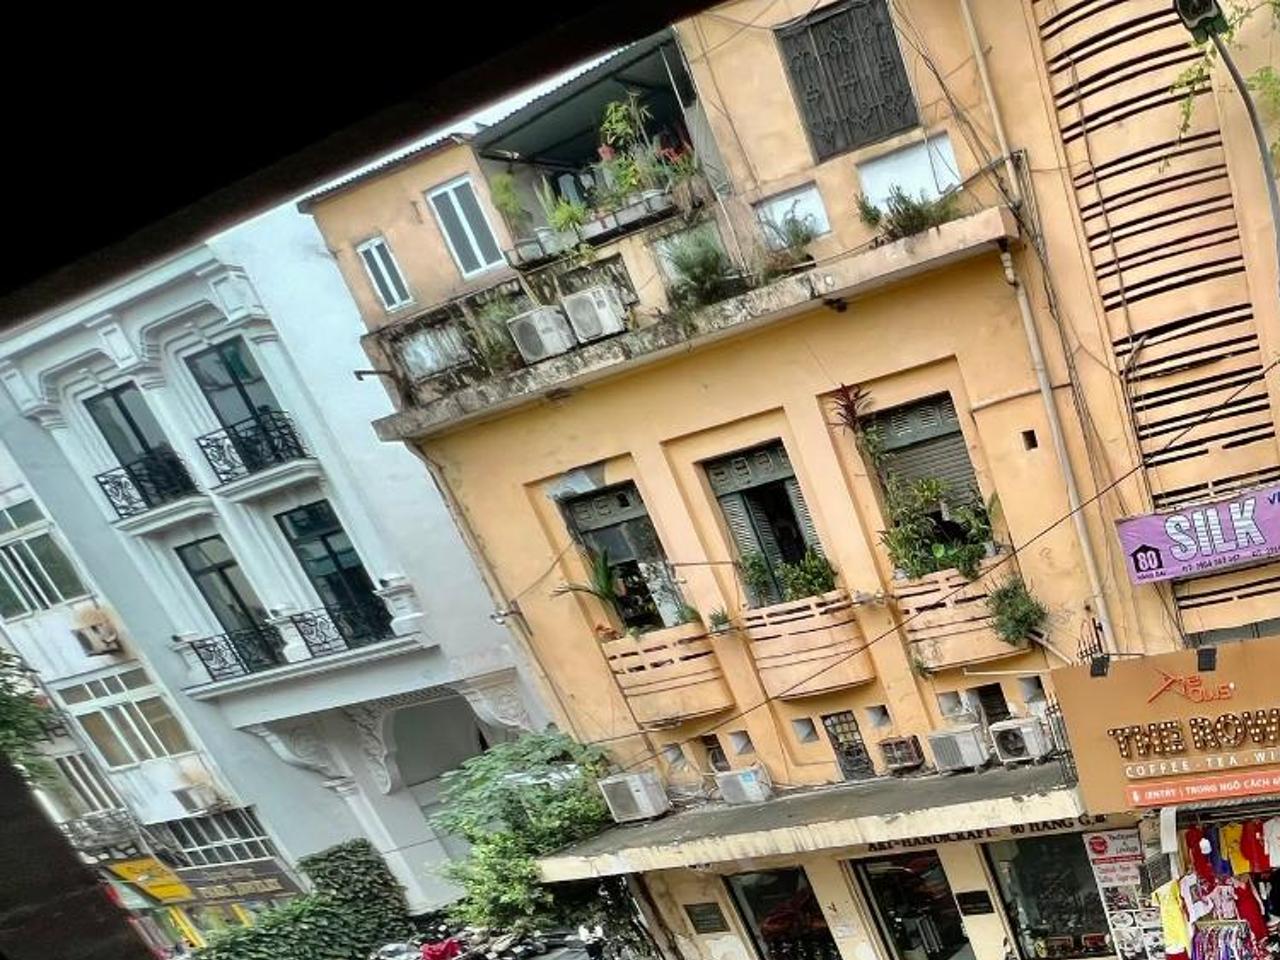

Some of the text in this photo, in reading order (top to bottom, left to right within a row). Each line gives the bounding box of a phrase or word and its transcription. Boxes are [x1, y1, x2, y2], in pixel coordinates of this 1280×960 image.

[1164, 496, 1267, 562] SILK
[1136, 550, 1158, 571] 80
[1107, 720, 1185, 759] THE
[1125, 760, 1190, 777] COFFEE
[1205, 752, 1240, 767] TEA
